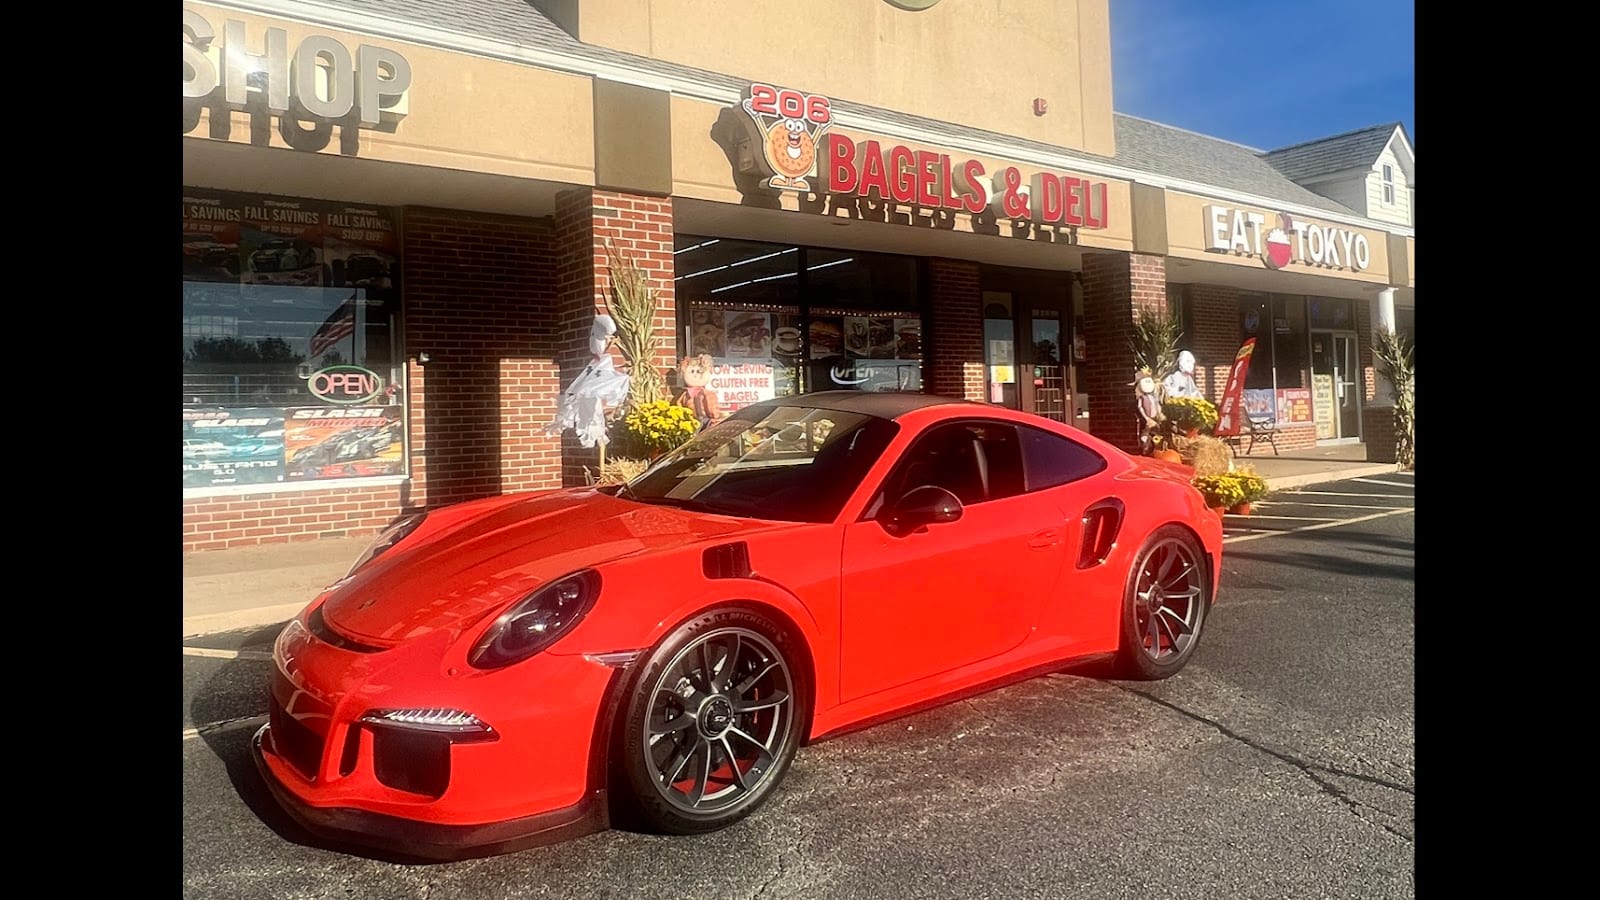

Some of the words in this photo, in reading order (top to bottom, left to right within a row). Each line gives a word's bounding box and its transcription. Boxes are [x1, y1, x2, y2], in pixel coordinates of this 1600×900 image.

[751, 85, 831, 124] 206
[827, 132, 987, 214] BAGELS
[1002, 166, 1031, 219] &
[1039, 172, 1109, 229] DELI
[191, 205, 241, 223] SAVINGS
[244, 206, 270, 221] FALL
[272, 208, 320, 225] SAVINGS
[327, 213, 351, 227] FALL
[1210, 204, 1265, 255] EAT
[1291, 220, 1370, 270] TOKYO
[733, 363, 772, 375] SERVING
[314, 373, 374, 395] OPEN
[711, 377, 746, 389] GLUTEN
[749, 377, 769, 388] FREE
[723, 391, 759, 402] BAGELS
[292, 408, 385, 419] SLASH
[729, 613, 777, 633] MICHELIN
